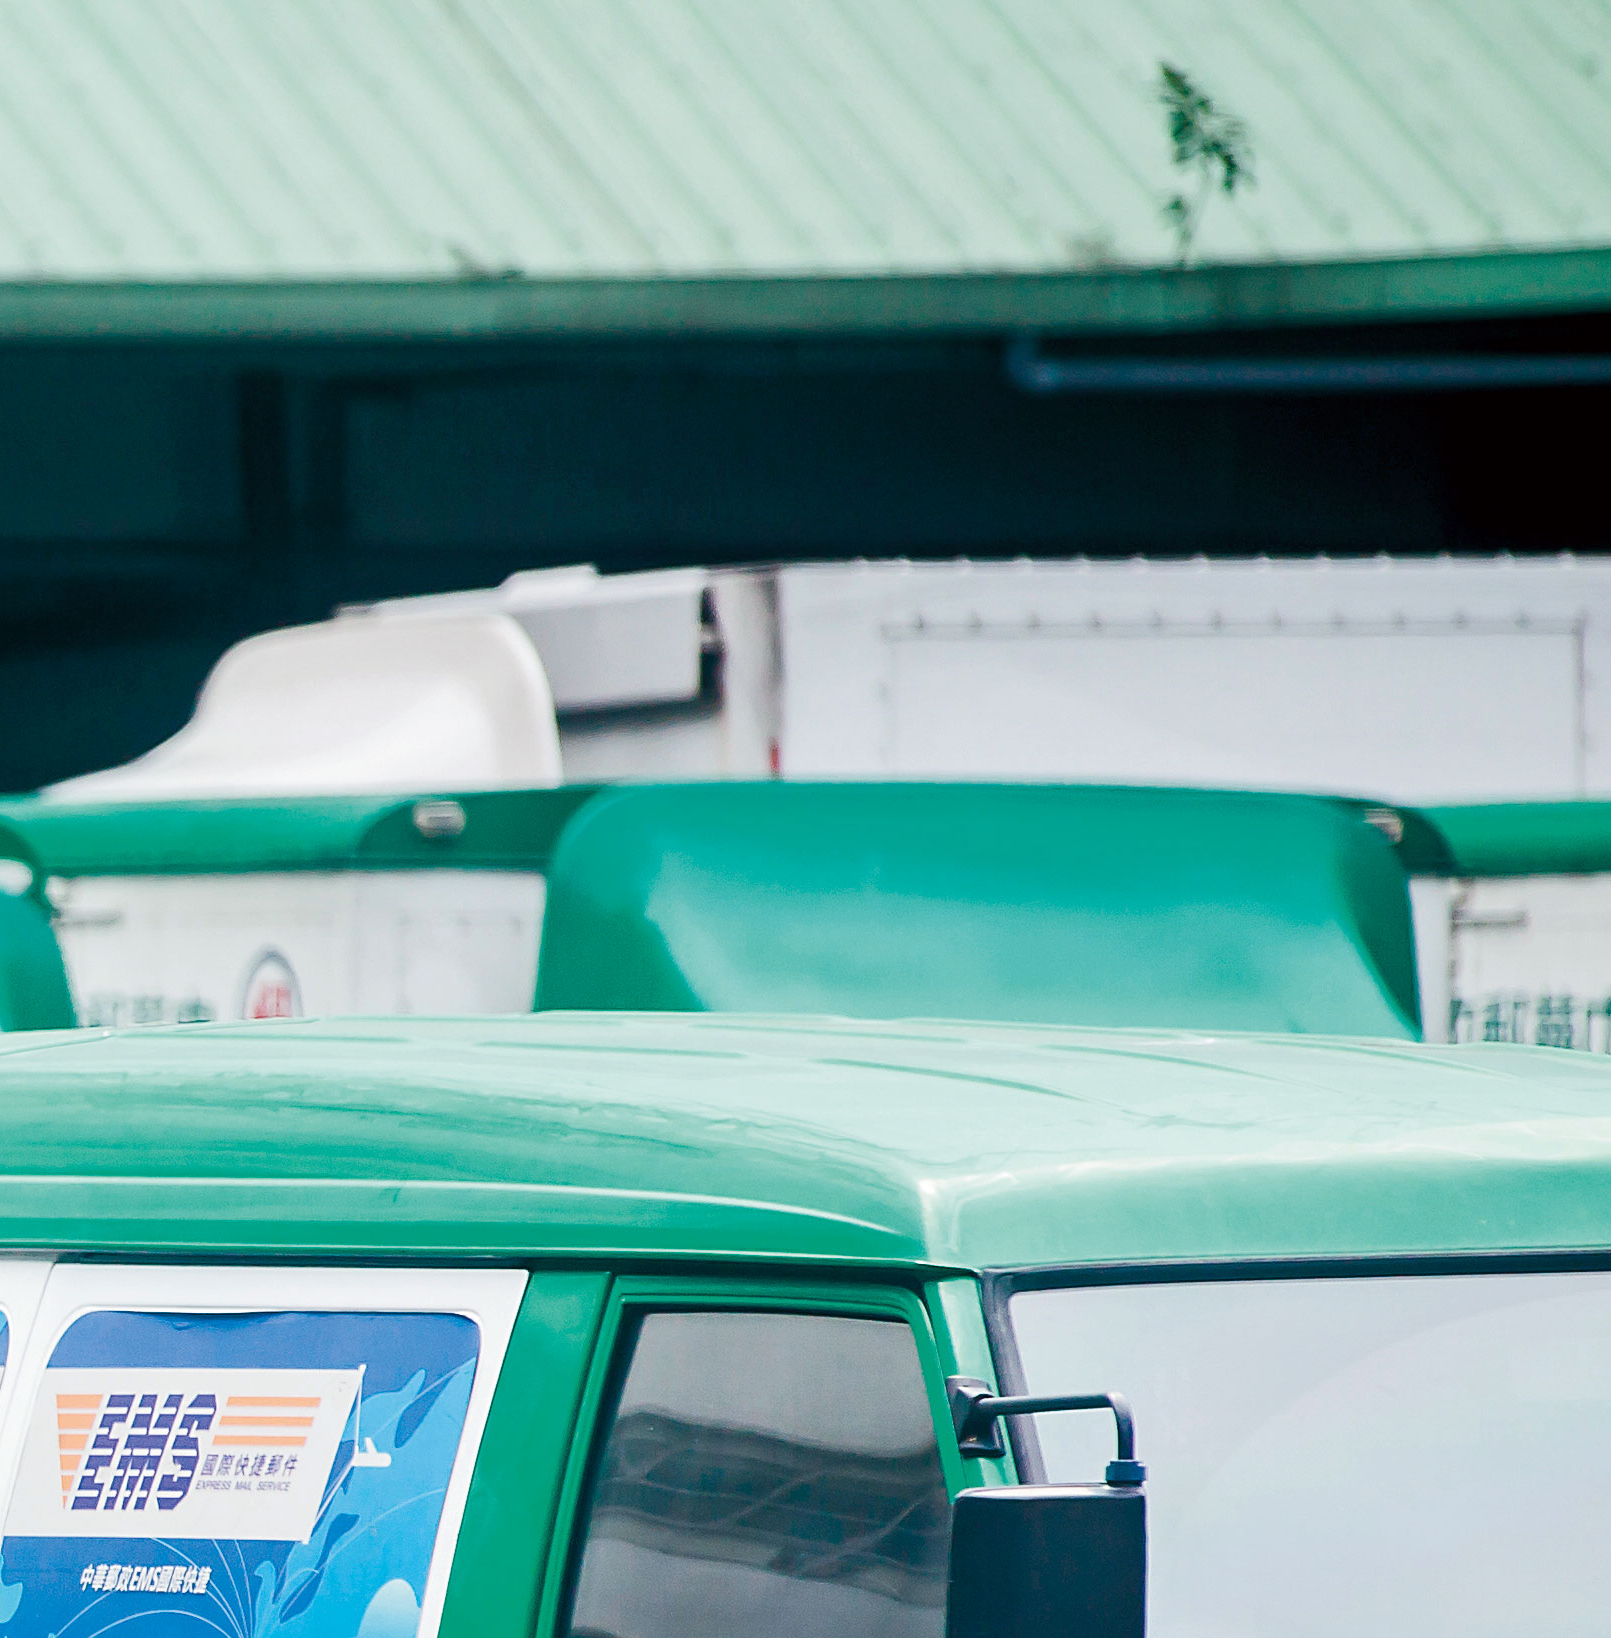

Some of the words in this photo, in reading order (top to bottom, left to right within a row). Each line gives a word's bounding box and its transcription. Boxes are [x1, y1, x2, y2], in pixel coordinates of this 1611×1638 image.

[71, 1394, 216, 1511] EMS
[200, 1453, 299, 1478] 國際快捷郵件
[195, 1479, 232, 1491] EXPRESS
[234, 1479, 252, 1491] MAIL
[256, 1480, 291, 1492] SERVICE
[80, 1563, 213, 1596] 中華郵政EMS國際快捷
